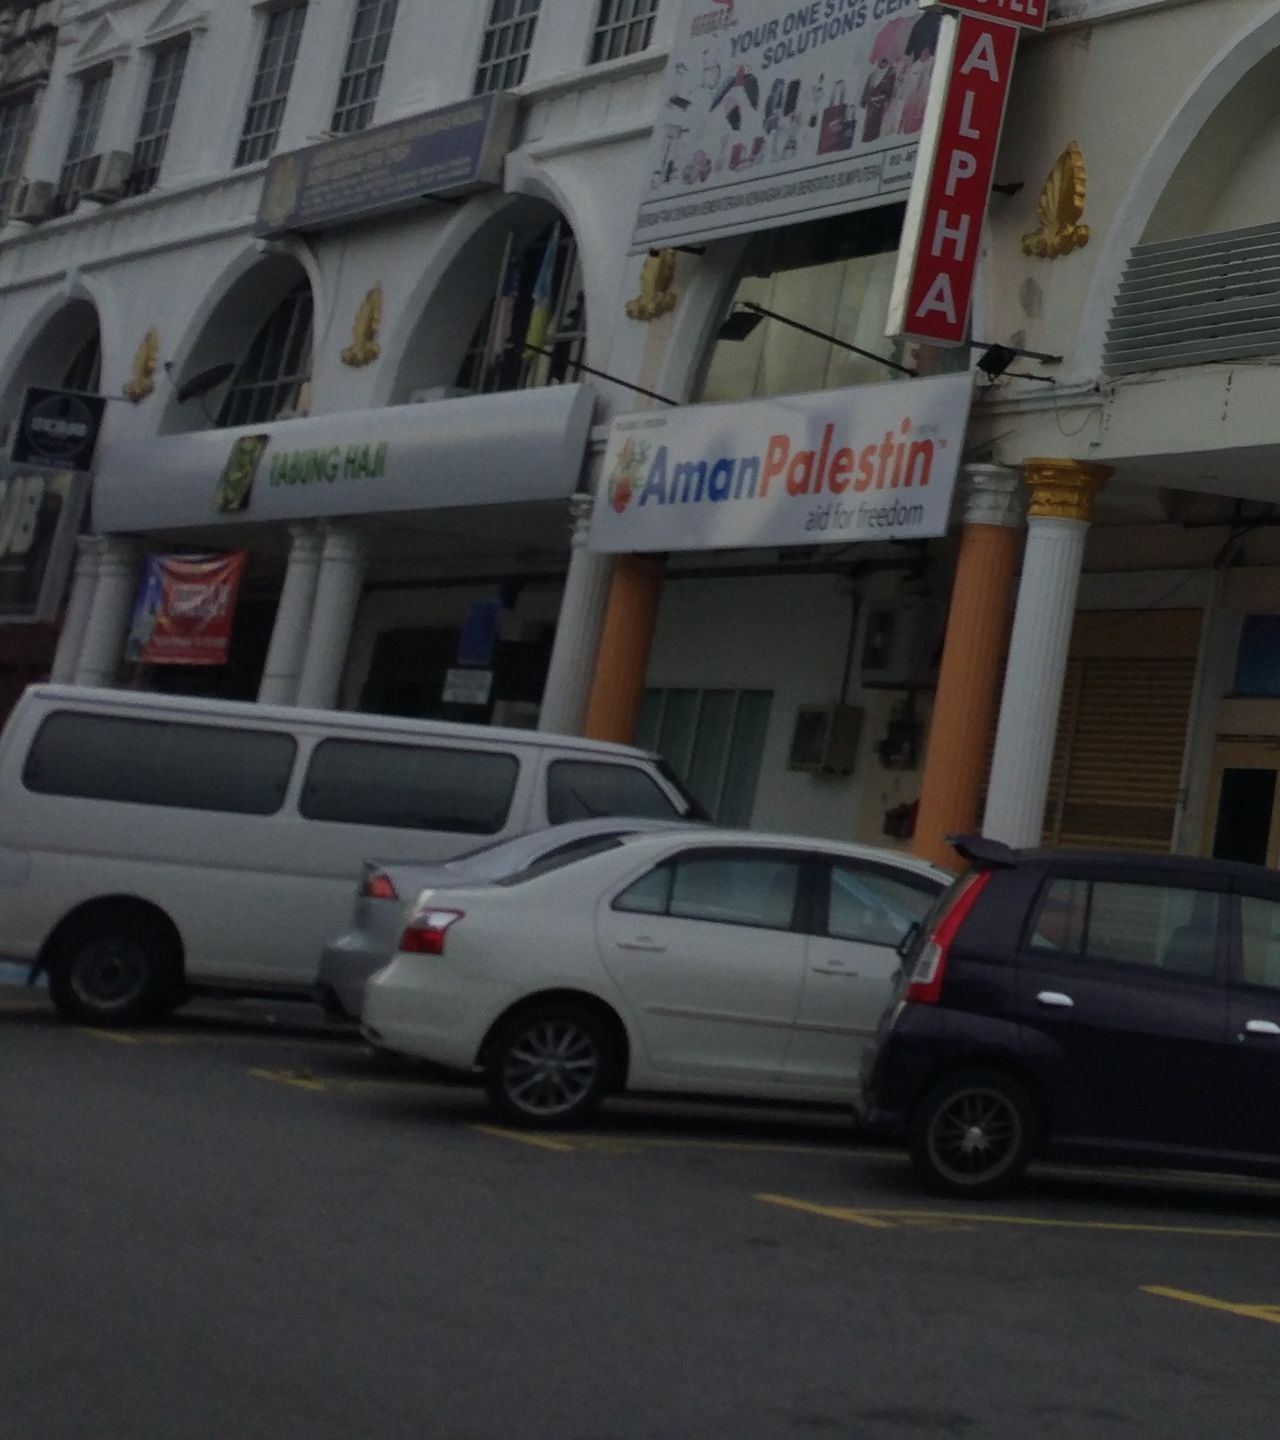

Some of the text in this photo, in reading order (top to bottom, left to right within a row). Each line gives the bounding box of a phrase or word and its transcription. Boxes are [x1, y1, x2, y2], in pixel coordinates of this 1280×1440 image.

[730, 19, 779, 59] YOUR
[783, 1, 821, 40] ONE
[762, 6, 869, 69] SOLUTIONS
[915, 31, 1002, 325] ALPHA
[270, 441, 389, 488] TABUNG HAJI
[639, 417, 934, 507] AmanPalestin
[805, 500, 925, 531] aid for freedom
